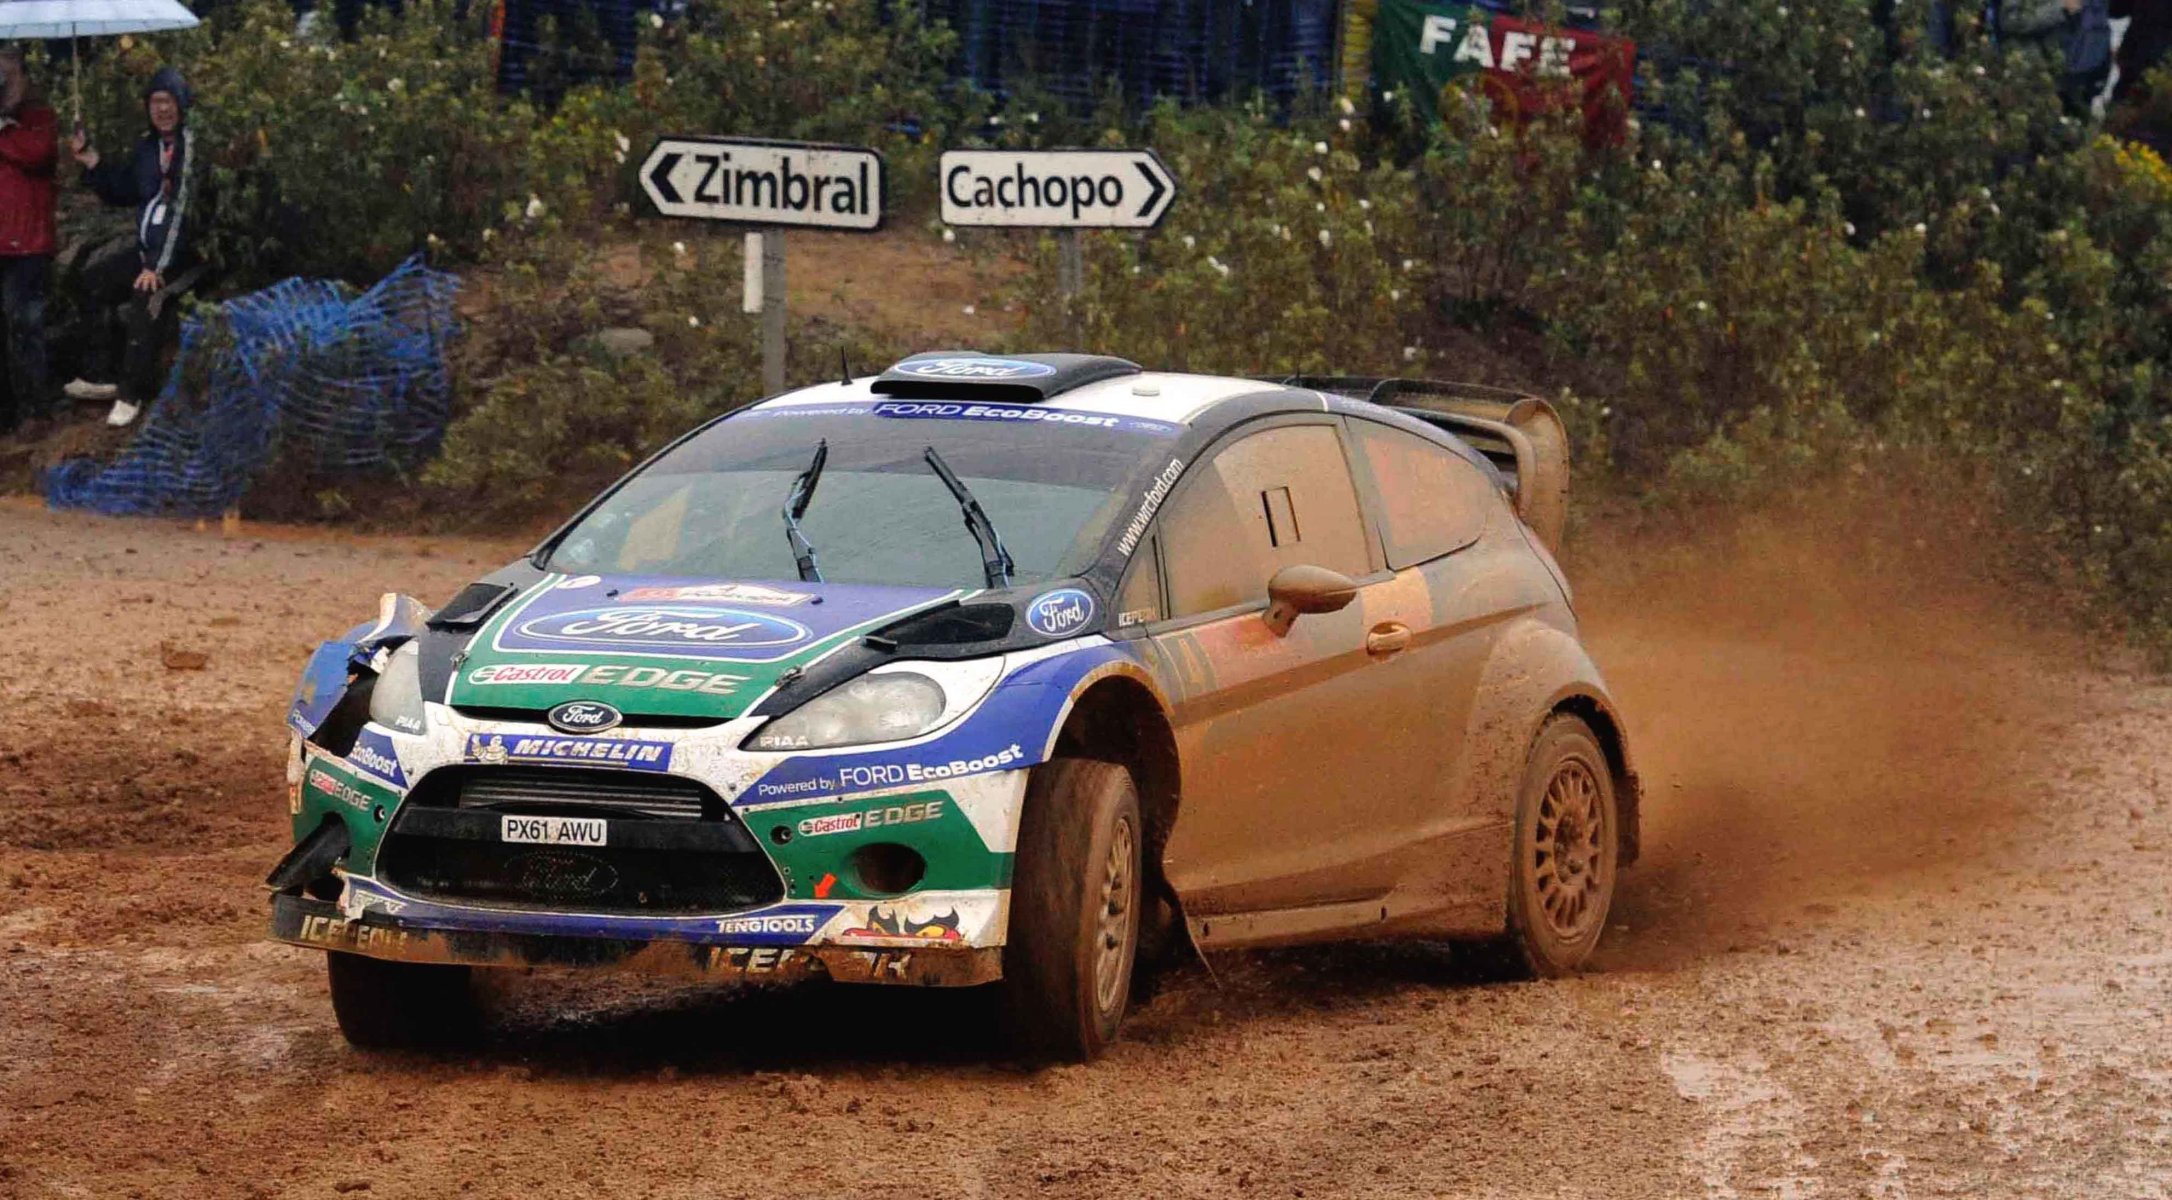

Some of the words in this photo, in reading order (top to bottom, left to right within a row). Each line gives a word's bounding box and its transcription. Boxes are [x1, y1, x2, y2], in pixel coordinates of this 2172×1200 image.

[1420, 15, 1576, 76] FAFE
[694, 154, 869, 214] Zimbral
[947, 165, 1124, 219] Cachopo
[917, 360, 1027, 376] Ford
[874, 404, 963, 416] FORD
[963, 406, 1119, 427] EcoBoost
[1117, 458, 1184, 557] www.wrcford.com
[561, 608, 761, 641] Ford
[1039, 597, 1085, 632] Ford
[494, 666, 577, 681] Castrol
[580, 664, 752, 695] EDGE
[562, 705, 604, 724] Ford
[513, 738, 663, 762] MICHELIN
[758, 781, 818, 796] Powered
[819, 777, 835, 792] by
[839, 765, 904, 787] FORD
[906, 743, 1025, 781] EcoBoost
[334, 782, 374, 812] EDGE
[507, 819, 549, 840] PX61
[558, 822, 602, 842] AWU
[814, 814, 861, 833] Castrol
[864, 801, 945, 828] EDGE
